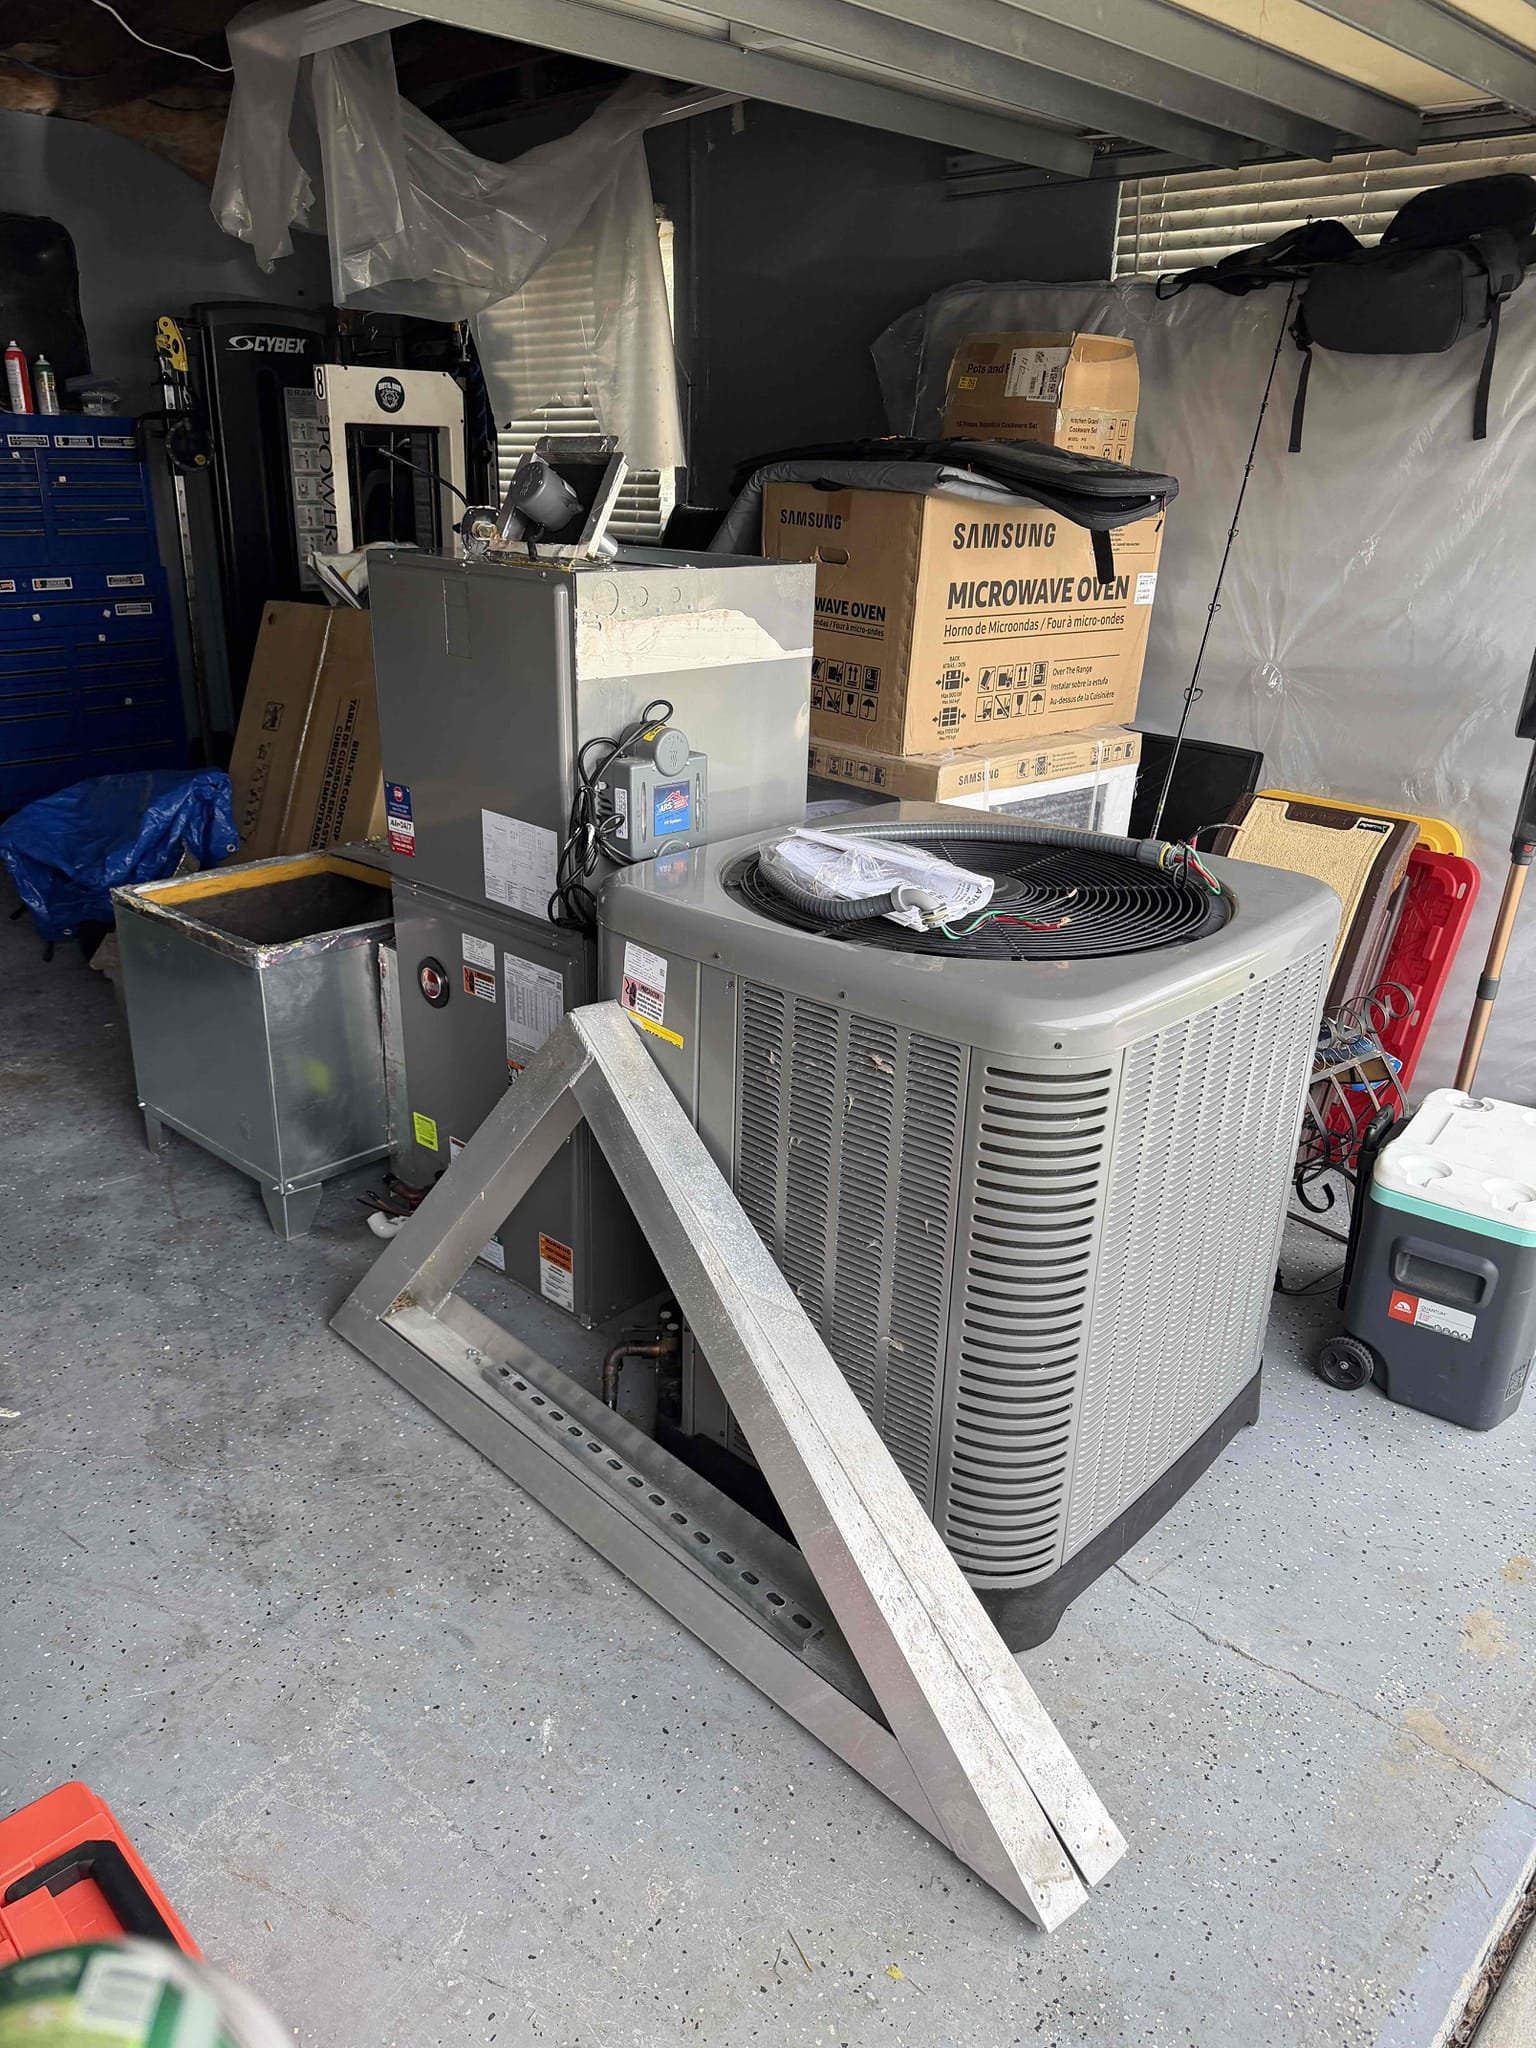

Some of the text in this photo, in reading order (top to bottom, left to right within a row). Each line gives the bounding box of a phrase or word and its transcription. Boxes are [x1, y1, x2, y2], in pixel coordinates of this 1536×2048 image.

[254, 336, 307, 354] CYBEX
[967, 363, 987, 375] Pots
[987, 363, 1004, 375] and
[287, 389, 316, 397] BRAV
[316, 367, 323, 399] 8
[781, 509, 842, 531] SAMSUNG
[952, 522, 1057, 550] SAMSUNG
[947, 577, 1075, 611] MICROWAVE
[1077, 575, 1131, 602] OVEN
[851, 602, 886, 622] OVEN
[832, 620, 845, 630] Four
[850, 624, 884, 637] micro-ondes
[944, 612, 1126, 639] Horno de Microondas / Four à micro-ondes
[1052, 665, 1093, 677] Over The Range
[1050, 681, 1071, 692] Instalar
[1071, 680, 1087, 689] sobre
[1092, 676, 1109, 686] estufa
[1049, 696, 1077, 706] Au-dessus
[1077, 695, 1084, 703] de
[344, 698, 358, 733] TABLE
[340, 733, 350, 748] DE
[329, 749, 347, 799] CUISSON
[311, 726, 343, 848] CUBIERTA EMPOTRADA
[332, 741, 360, 841] BUILT-IN COOKTOP
